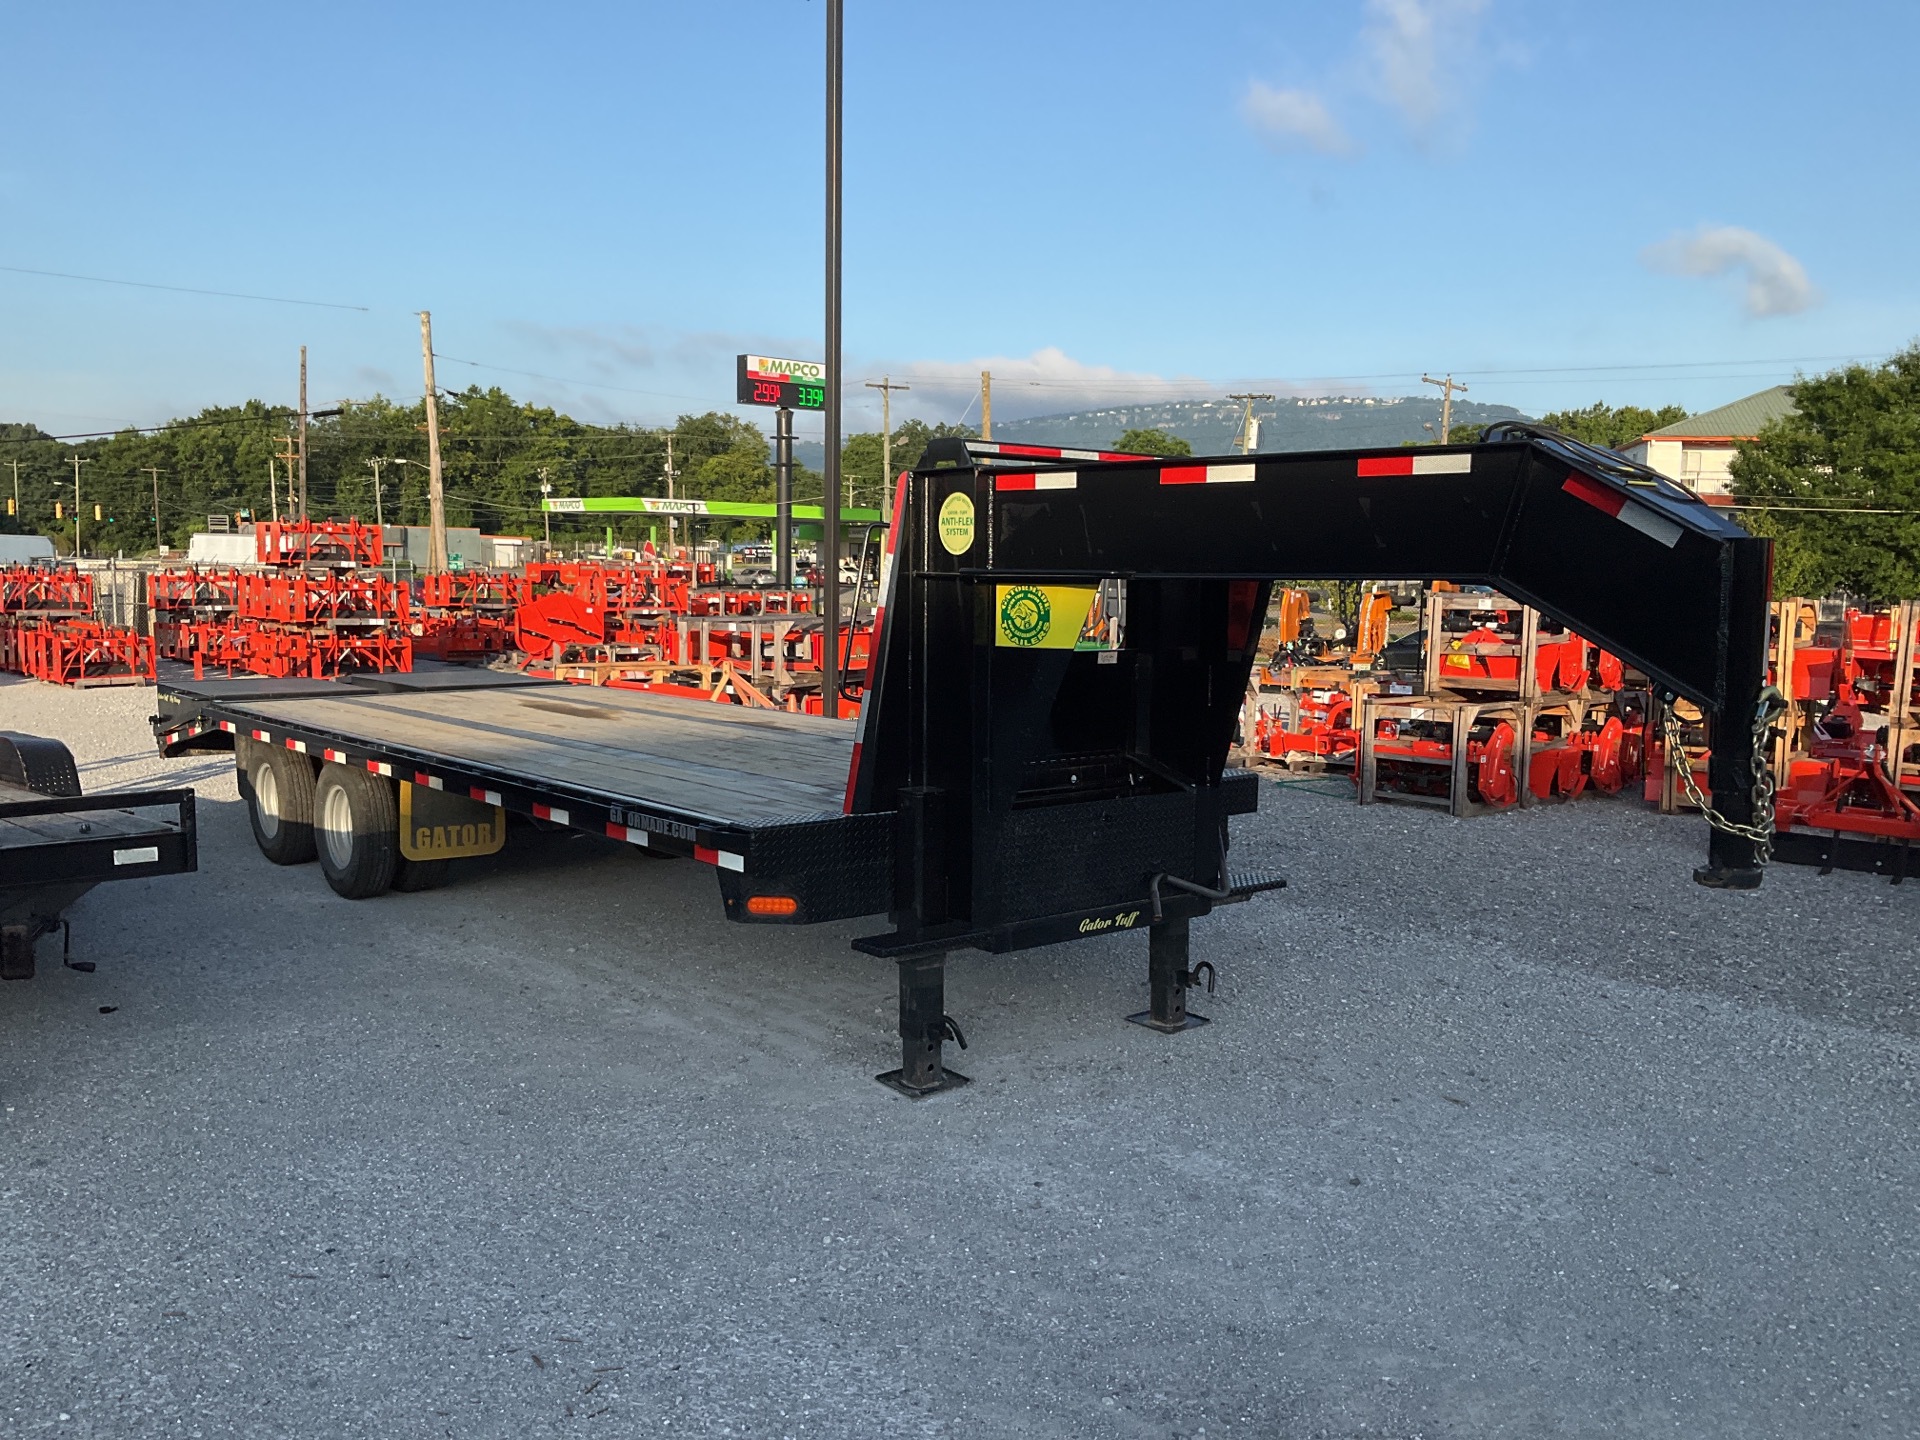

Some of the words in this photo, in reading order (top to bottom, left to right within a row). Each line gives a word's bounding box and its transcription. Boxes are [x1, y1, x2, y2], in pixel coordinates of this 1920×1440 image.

[769, 360, 819, 378] MAPCO
[558, 500, 581, 510] MAPCO
[661, 501, 701, 512] MAPCO
[941, 517, 974, 526] ANTI-FLEX
[946, 528, 969, 536] SYSTEM
[1001, 585, 1051, 611] GATORMADE
[1001, 619, 1050, 646] TRAILERS
[416, 822, 491, 849] GATOR
[1079, 917, 1112, 933] Gator
[1115, 911, 1140, 928] Tuff
